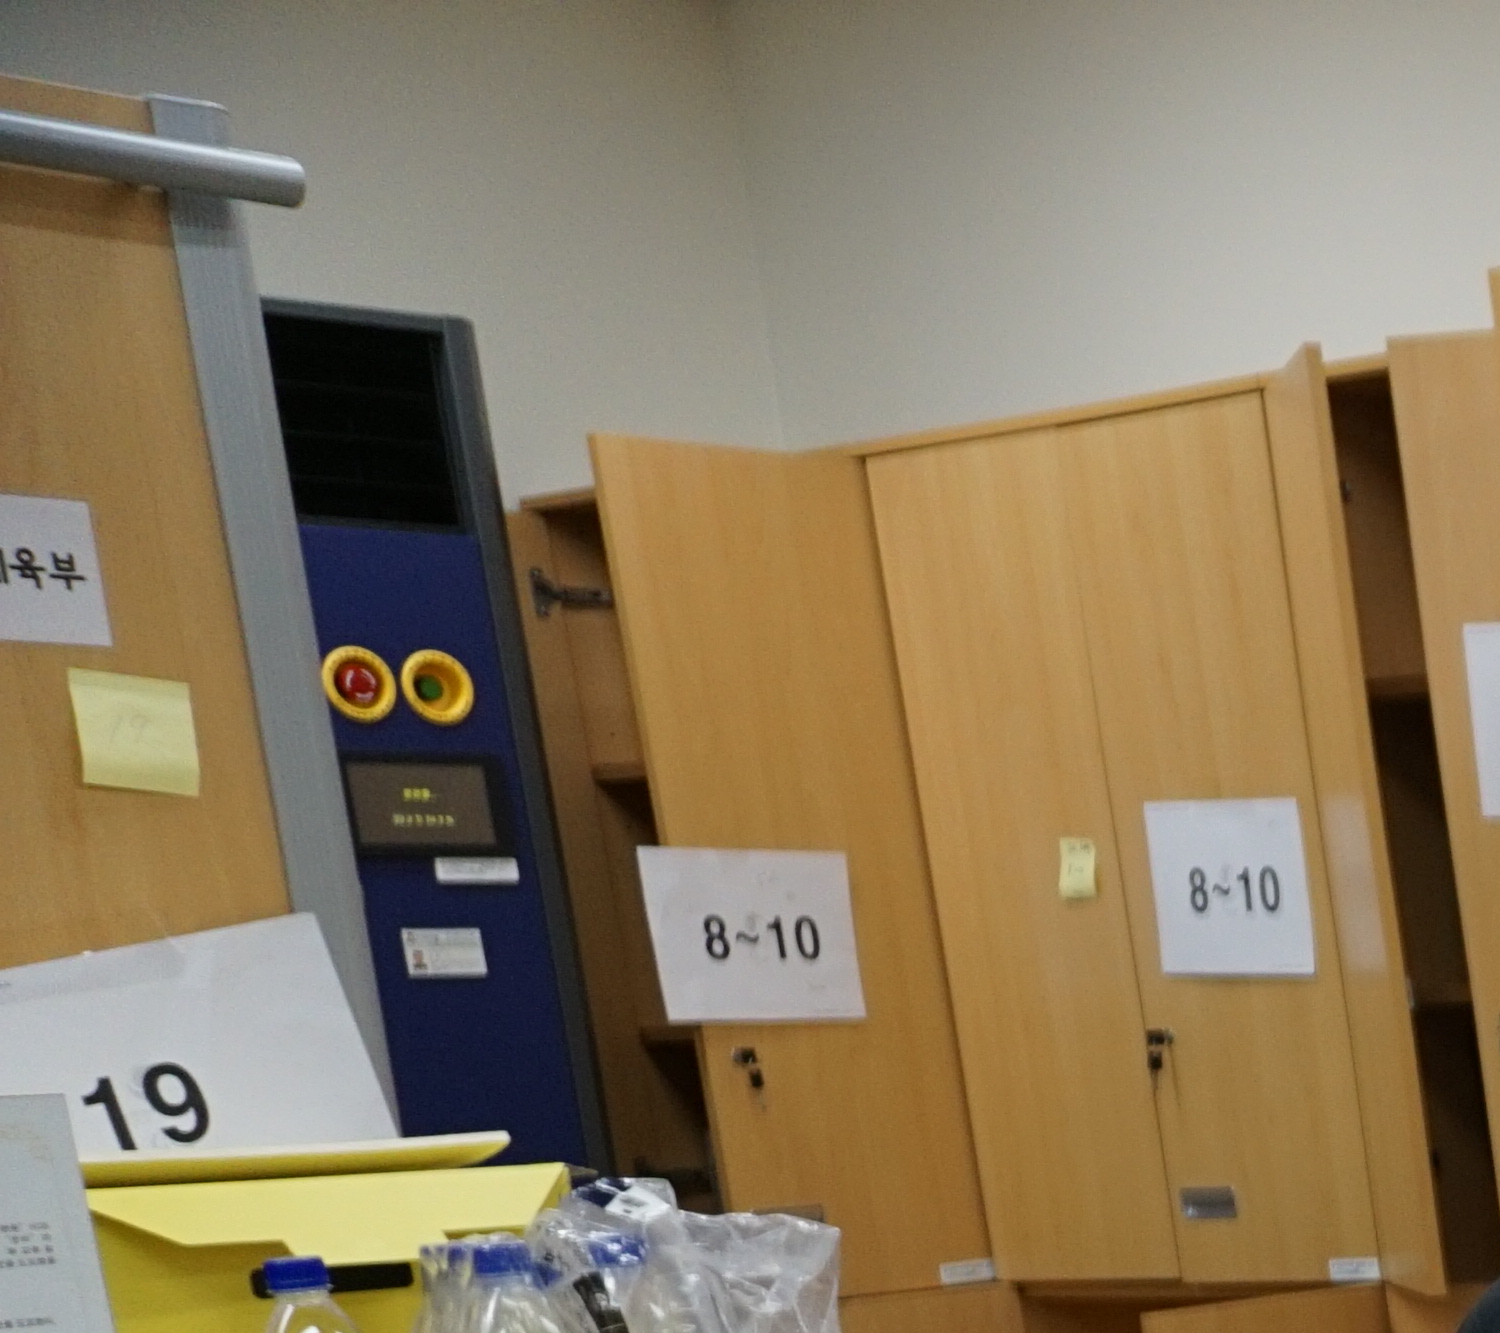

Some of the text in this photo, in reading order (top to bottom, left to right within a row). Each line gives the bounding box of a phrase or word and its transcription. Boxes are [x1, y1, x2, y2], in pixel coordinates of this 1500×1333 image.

[0, 549, 87, 592] 육부
[1188, 866, 1282, 914] 8~10
[704, 914, 822, 961] 8~10
[82, 1061, 211, 1152] 19
